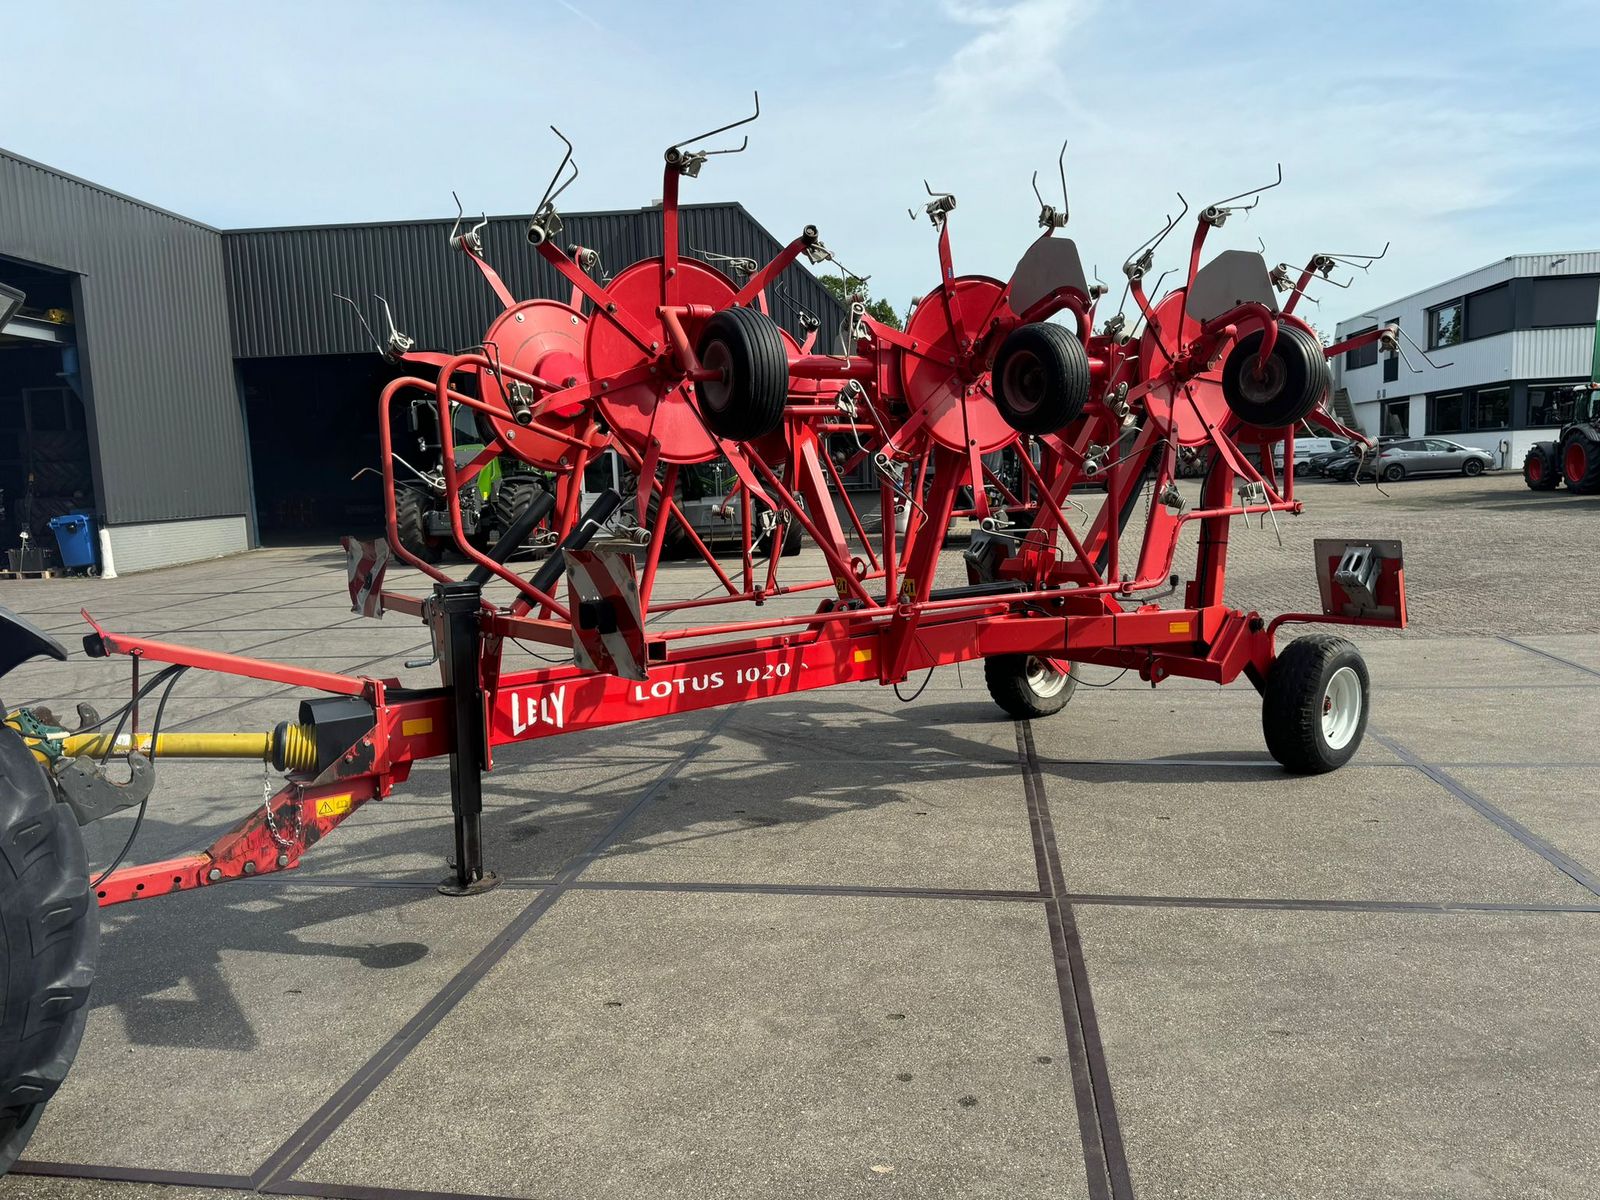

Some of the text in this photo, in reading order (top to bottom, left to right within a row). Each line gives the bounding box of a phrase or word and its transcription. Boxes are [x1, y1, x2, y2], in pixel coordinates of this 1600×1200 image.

[635, 662, 791, 701] LOTUS 1020
[511, 685, 565, 736] LELY
